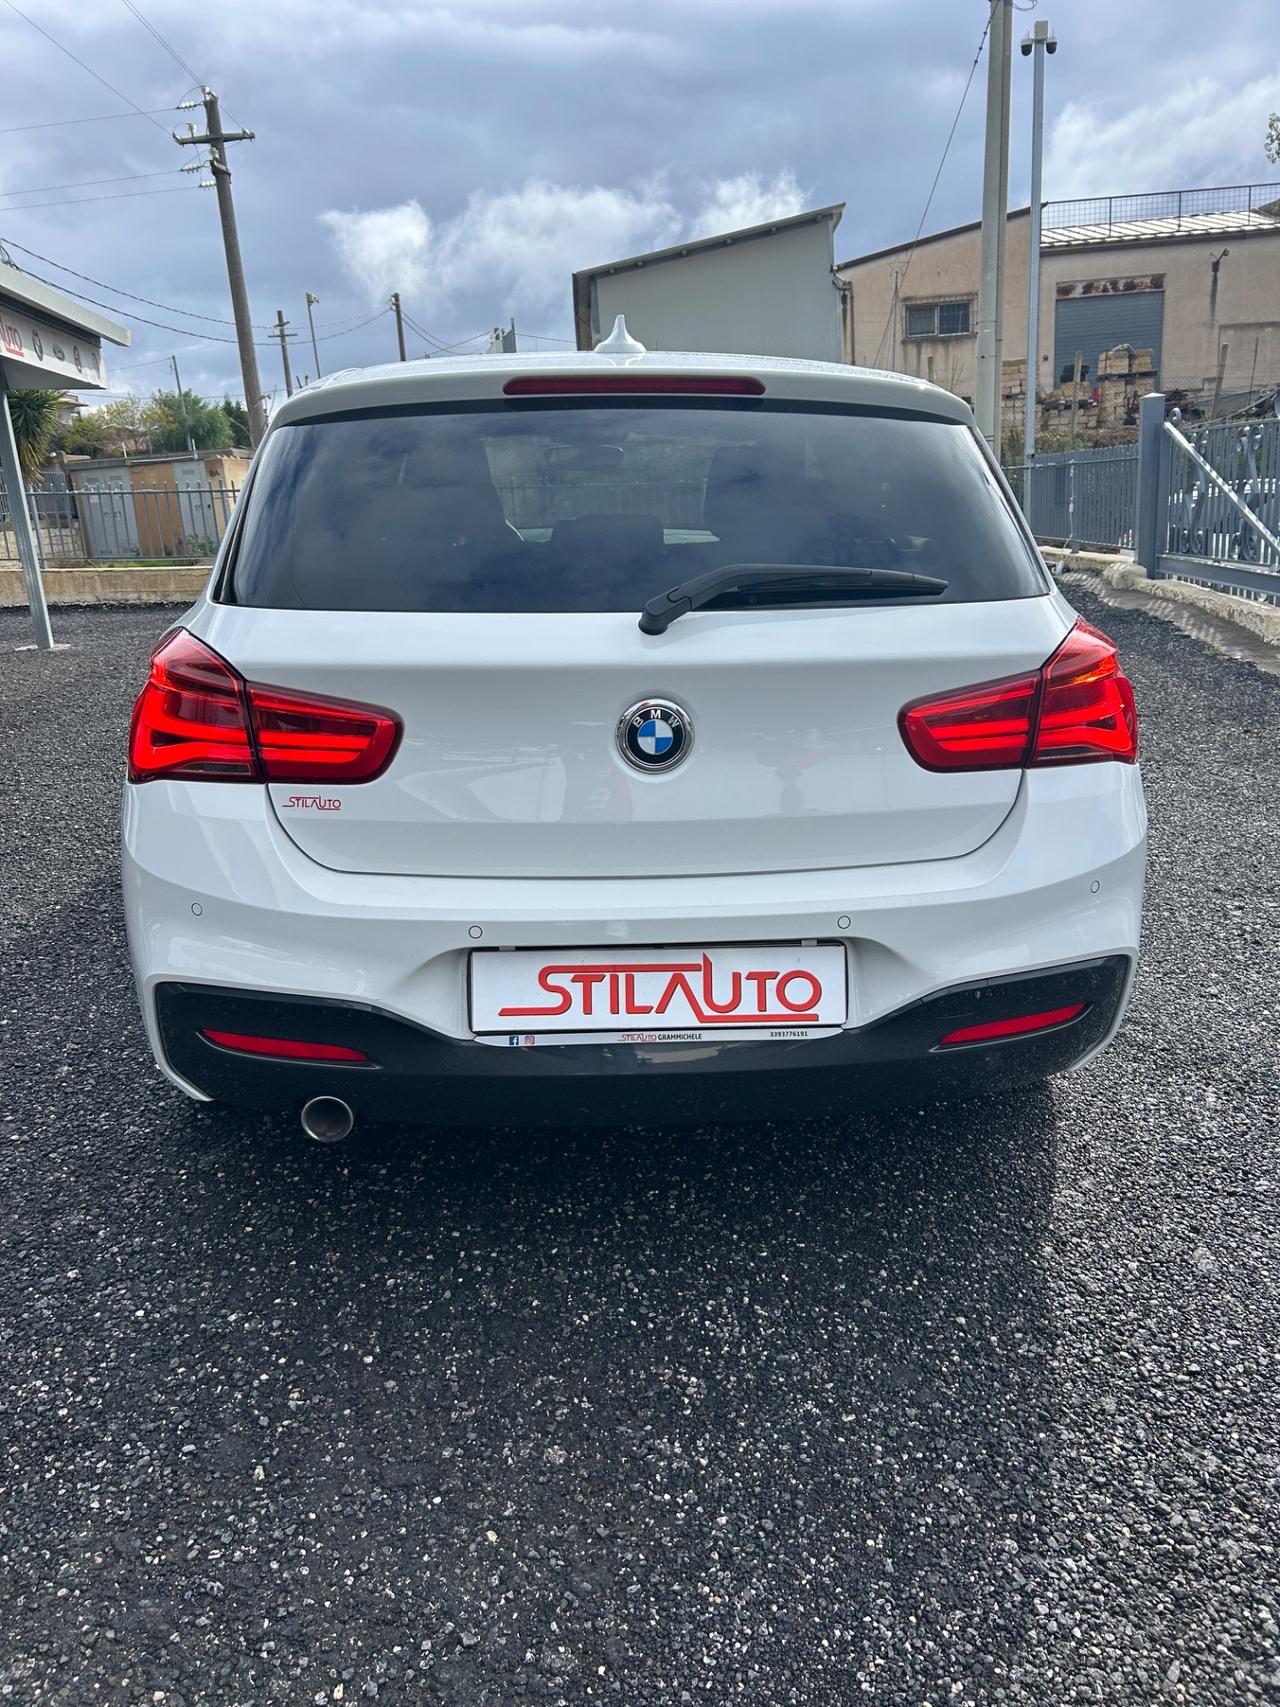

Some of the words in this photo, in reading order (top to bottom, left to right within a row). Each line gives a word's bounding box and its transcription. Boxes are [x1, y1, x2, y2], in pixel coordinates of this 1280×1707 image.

[632, 709, 680, 729] BMW
[282, 795, 342, 811] STILAUTO
[498, 952, 823, 1024] STILAUTO
[617, 1032, 657, 1043] STILAUTO
[658, 1033, 702, 1041] GRAMMICHELE
[769, 1030, 808, 1038] 3393776191
